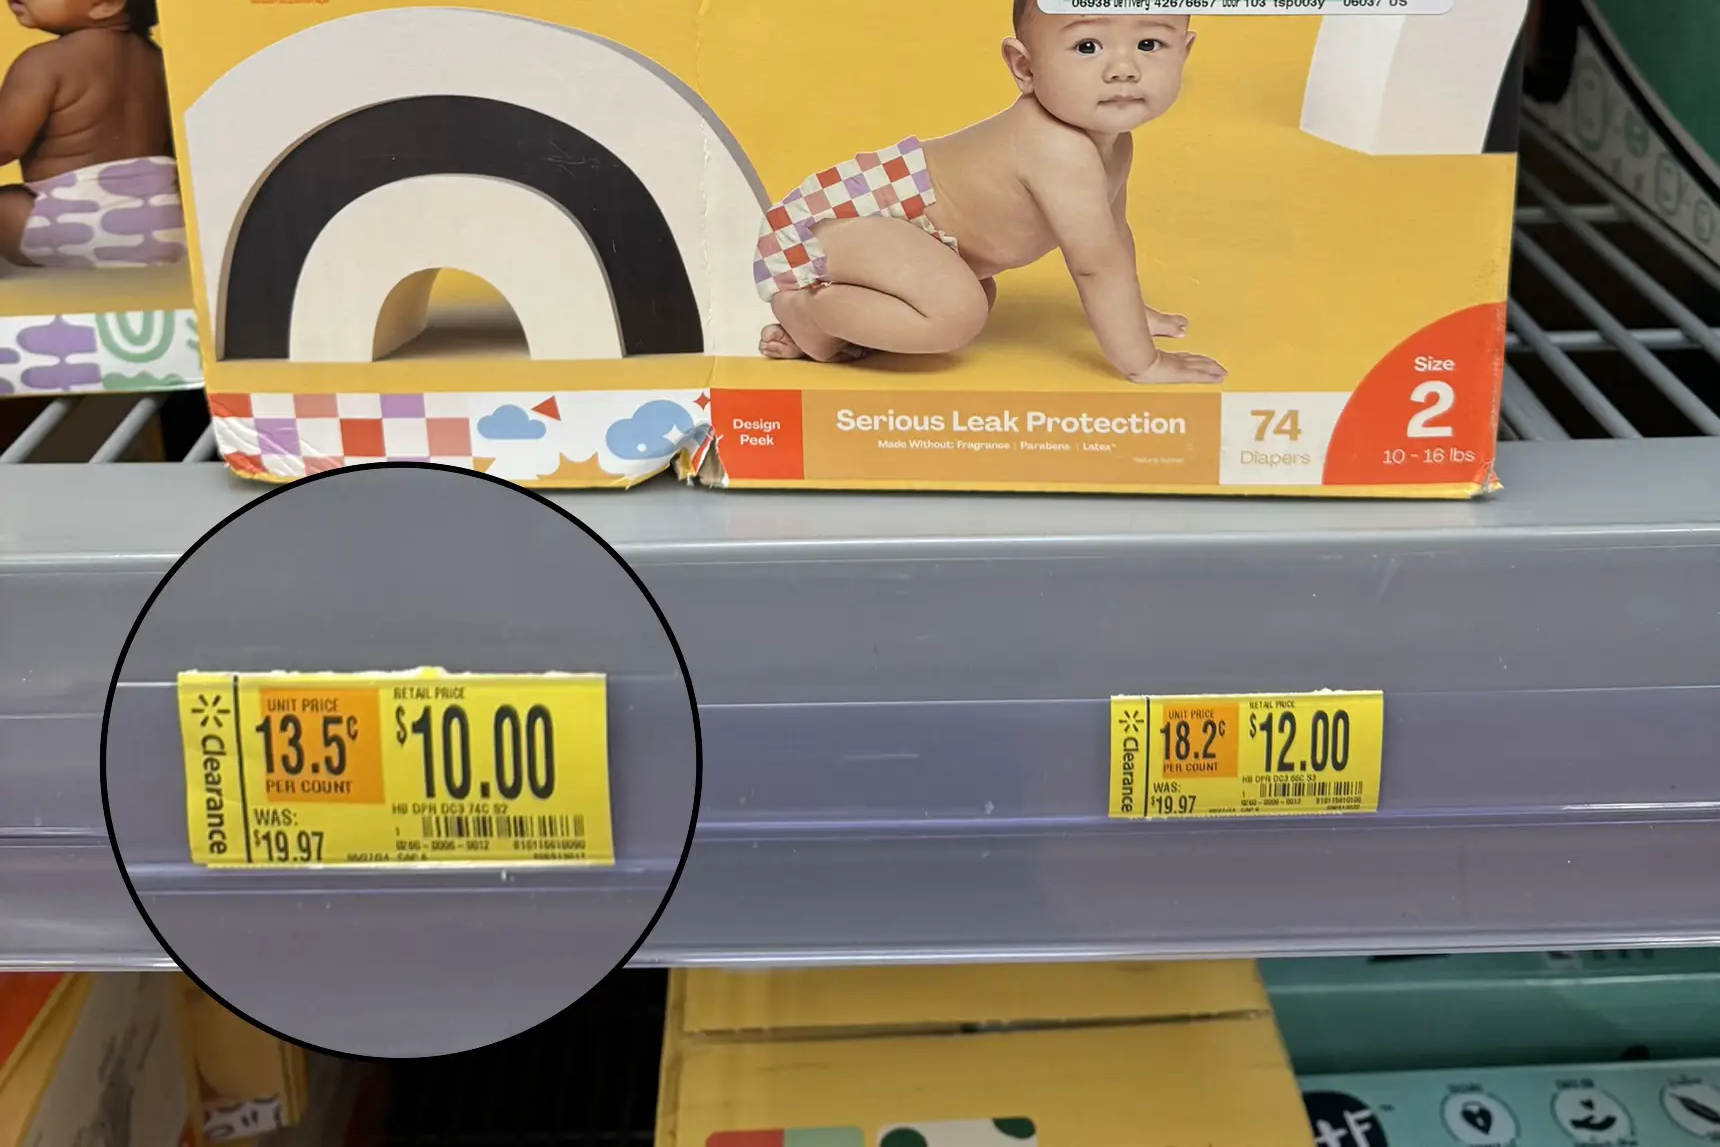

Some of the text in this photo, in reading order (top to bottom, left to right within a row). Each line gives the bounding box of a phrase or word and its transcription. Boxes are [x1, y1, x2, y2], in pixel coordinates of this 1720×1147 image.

[1414, 356, 1456, 372] Size
[1407, 380, 1455, 438] 2
[733, 418, 781, 432] Design
[836, 409, 1186, 434] Serious Leak Protection
[1250, 409, 1302, 442] 74
[740, 434, 774, 446] Peek
[878, 440, 906, 449] Made
[909, 440, 955, 450] Without:
[957, 440, 1010, 452] Fragrance
[1020, 441, 1071, 451] Parabens
[1240, 449, 1311, 468] Diapers
[1383, 449, 1405, 465] 10
[1424, 448, 1445, 463] 16
[1450, 447, 1476, 462] lbs
[394, 687, 466, 700] RETAIL PRICE
[267, 698, 338, 713] UNIT PRICE
[1250, 700, 1296, 710] RETAIL PRICE
[1168, 709, 1214, 720] UNIT PRICE
[1250, 709, 1350, 773] $12.00
[395, 703, 556, 800] $10.00
[1121, 736, 1139, 813] Clearance
[1163, 762, 1218, 773] PER COUNT
[200, 734, 228, 855] Clearance
[266, 779, 352, 794] PER COUNT
[1153, 782, 1181, 794] WAS:
[1151, 795, 1196, 814] $19.97
[254, 808, 299, 826] WAS:
[254, 829, 325, 863] $19.97
